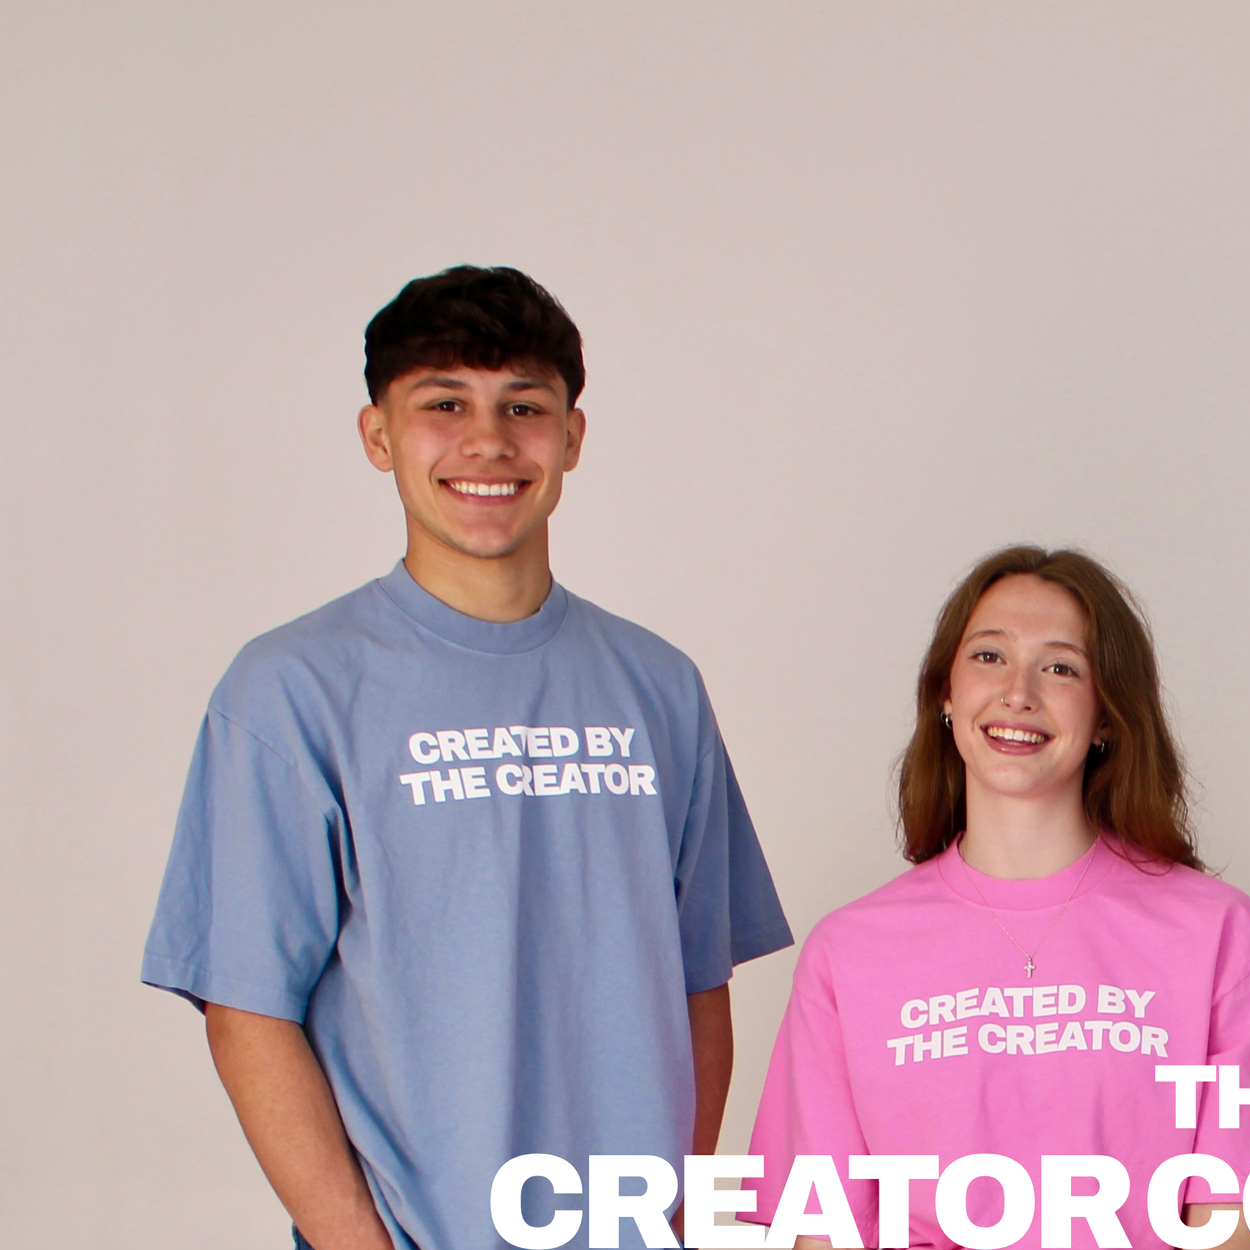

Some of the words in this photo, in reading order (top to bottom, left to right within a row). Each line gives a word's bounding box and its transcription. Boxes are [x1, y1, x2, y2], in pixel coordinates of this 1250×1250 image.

[407, 725, 580, 765] CREATED
[584, 725, 636, 758] BY
[399, 766, 492, 806] THE
[495, 763, 658, 797] CREATOR
[900, 984, 1087, 1029] CREATED
[1097, 984, 1156, 1019] BY
[886, 1026, 969, 1067] THE
[977, 1020, 1169, 1058] CREATOR
